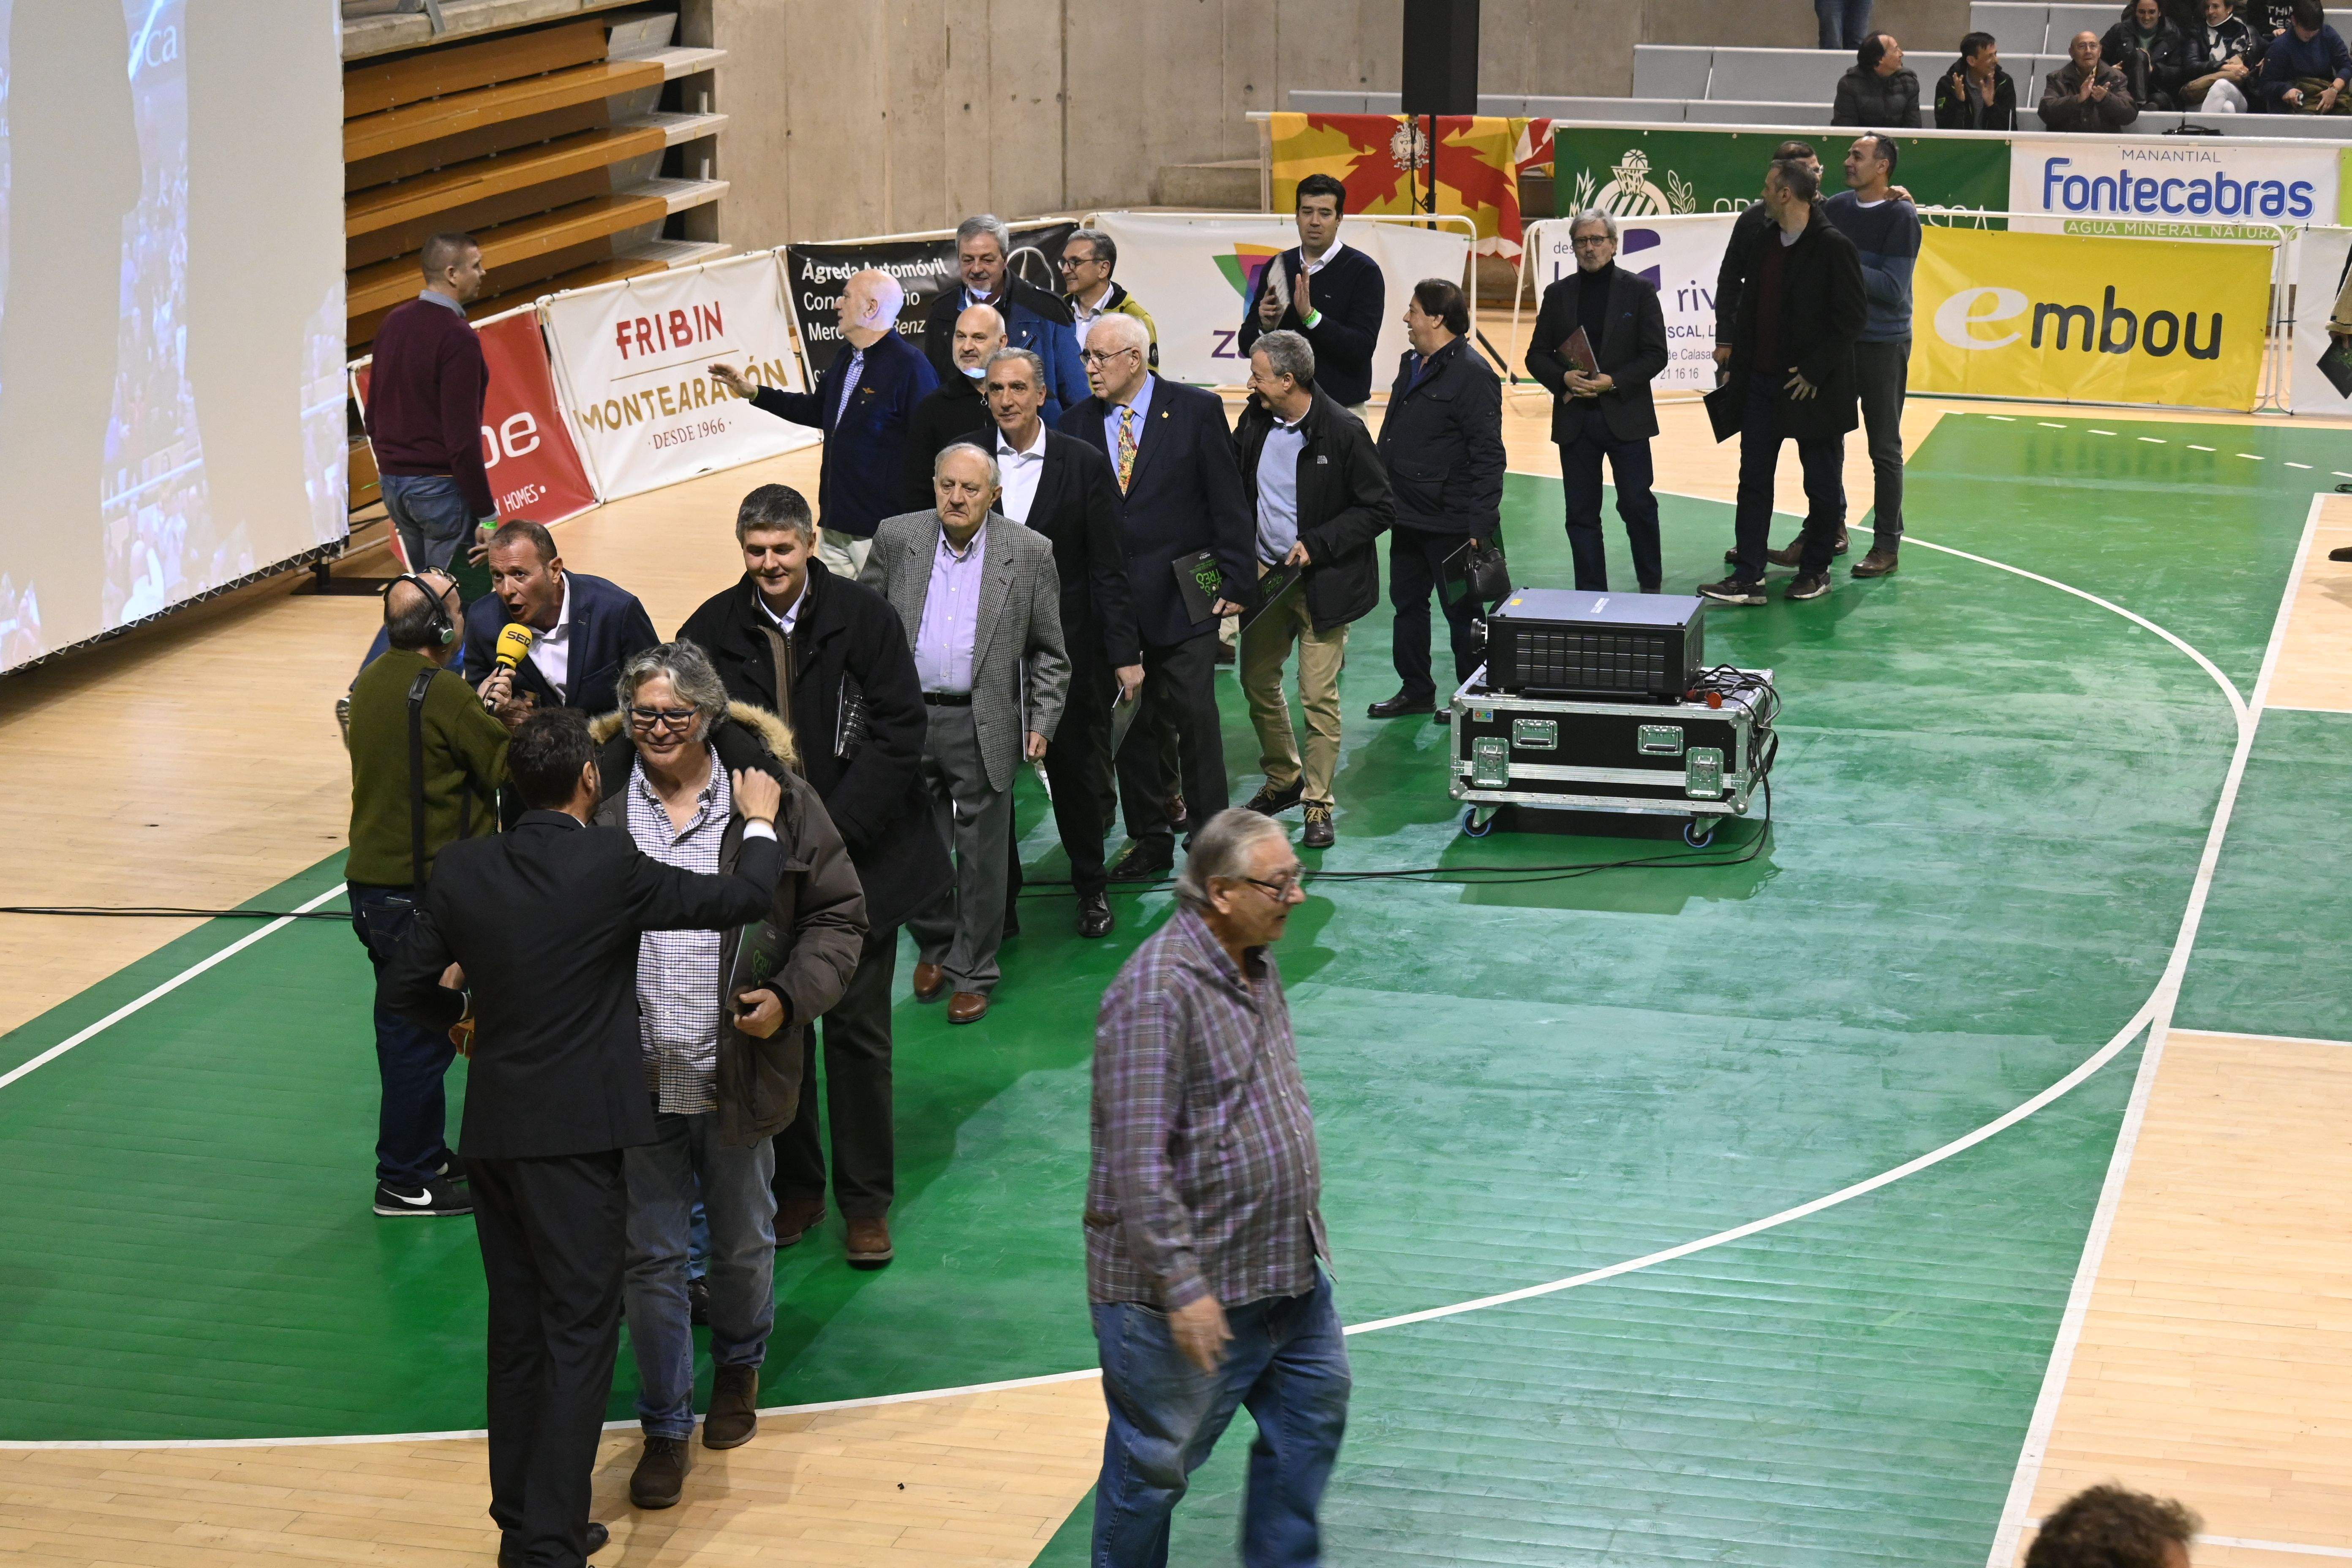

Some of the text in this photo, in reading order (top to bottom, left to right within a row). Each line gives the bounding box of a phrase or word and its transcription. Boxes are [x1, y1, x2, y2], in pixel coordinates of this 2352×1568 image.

[2122, 150, 2221, 163] MANANTIAL
[2043, 157, 2316, 218] Fontecabras
[2067, 221, 2116, 234] AGUA
[2125, 223, 2203, 237] MINERAL
[616, 301, 724, 360] FRIBIN
[1934, 285, 2223, 360] embou
[1665, 325, 1704, 340] SCAL,
[1681, 348, 1714, 360] Calasa
[1660, 368, 1699, 379] 21 16 16
[653, 418, 725, 449] DESDE 1966
[502, 484, 539, 512] HOMES
[506, 631, 531, 648] SER
